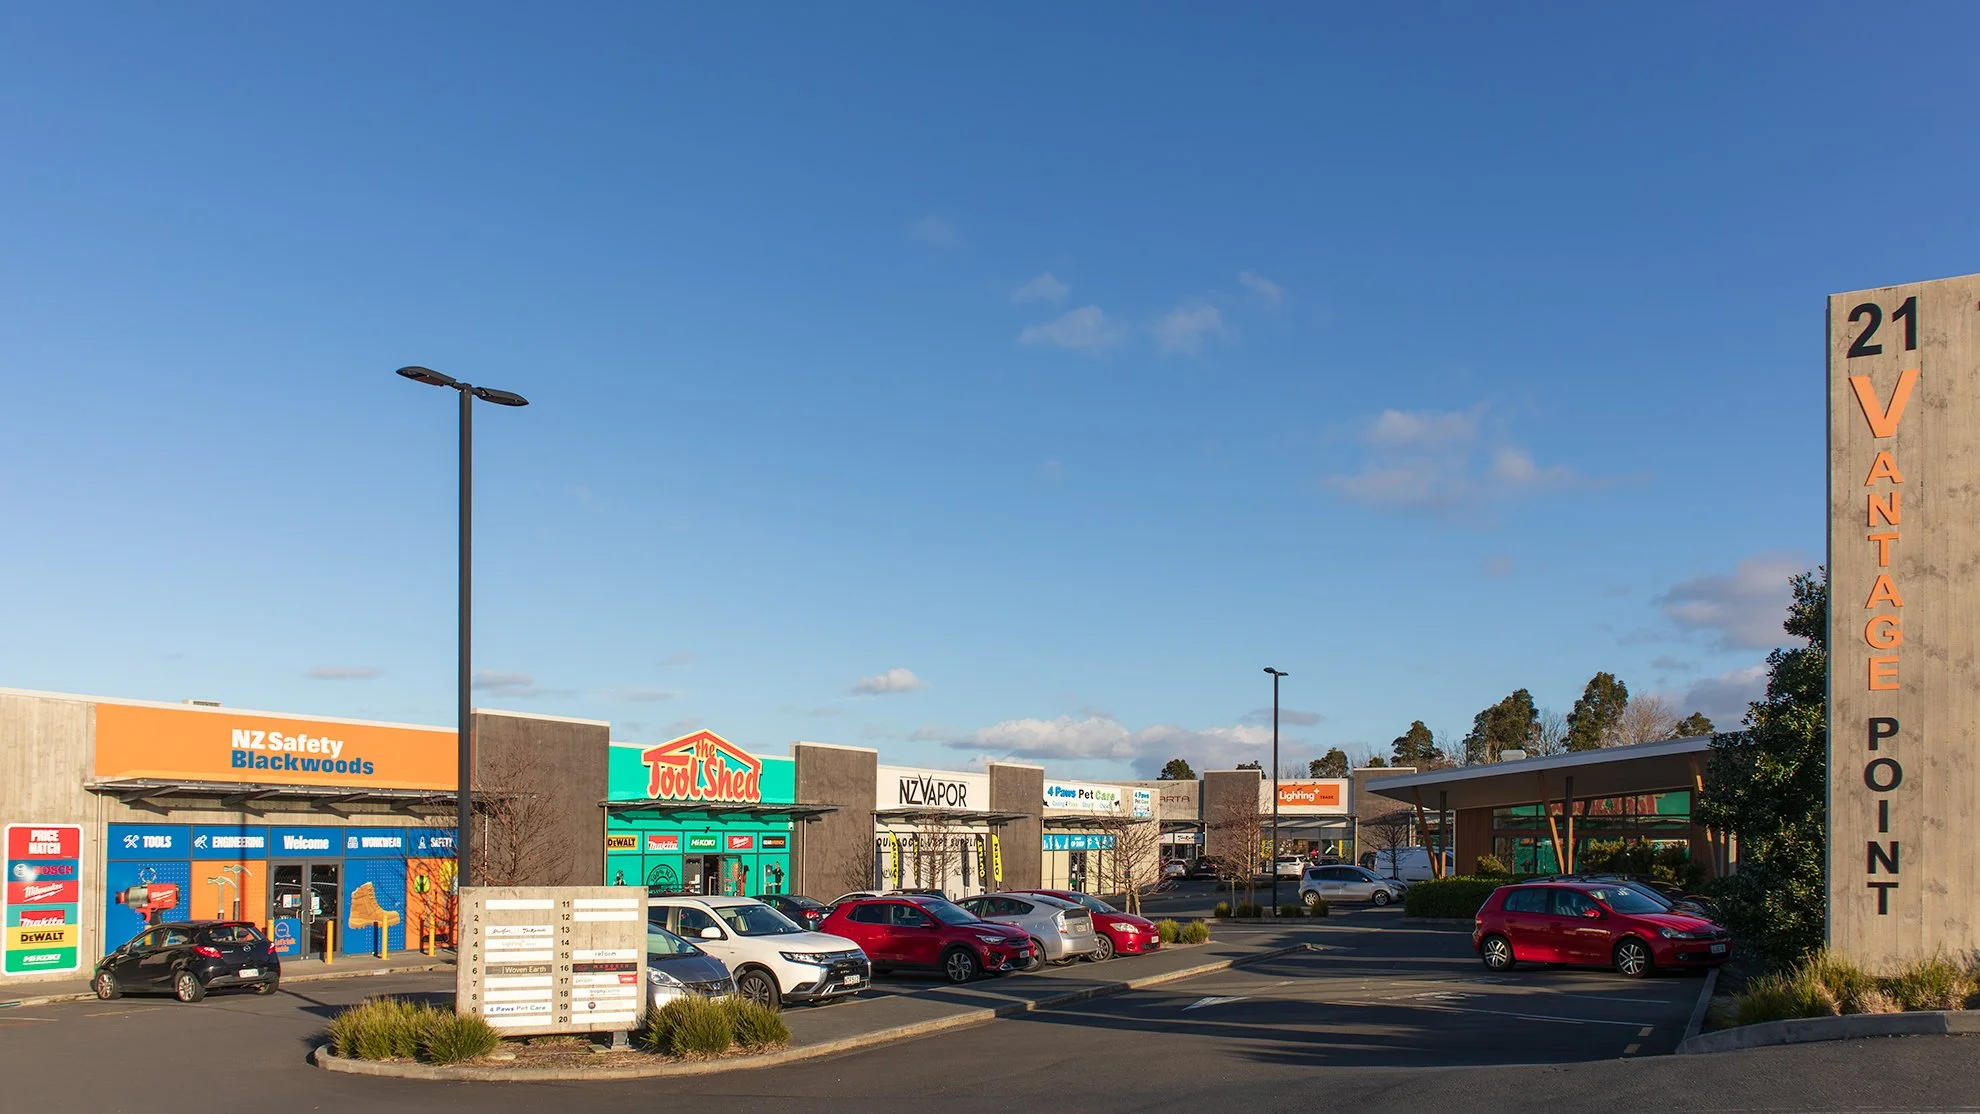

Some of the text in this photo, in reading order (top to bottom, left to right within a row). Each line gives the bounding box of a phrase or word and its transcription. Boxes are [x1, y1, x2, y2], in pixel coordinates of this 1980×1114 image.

[1846, 296, 1917, 358] 21
[1848, 367, 1920, 691] VANTAGE
[232, 728, 344, 758] NZ Safety
[696, 739, 716, 759] the
[232, 750, 374, 774] Blackwoods
[644, 754, 760, 801] Tool Shed
[1048, 786, 1115, 800] 4 Paws Pet Care
[1864, 716, 1903, 915] POINT
[30, 830, 59, 842] PRICE
[142, 836, 172, 848] TOOLS
[212, 836, 264, 848] ENGINEERING
[283, 836, 329, 850] Welcome
[362, 837, 402, 848] WORKWEAR
[430, 837, 452, 848] SAFETY
[28, 842, 60, 854] MATCH
